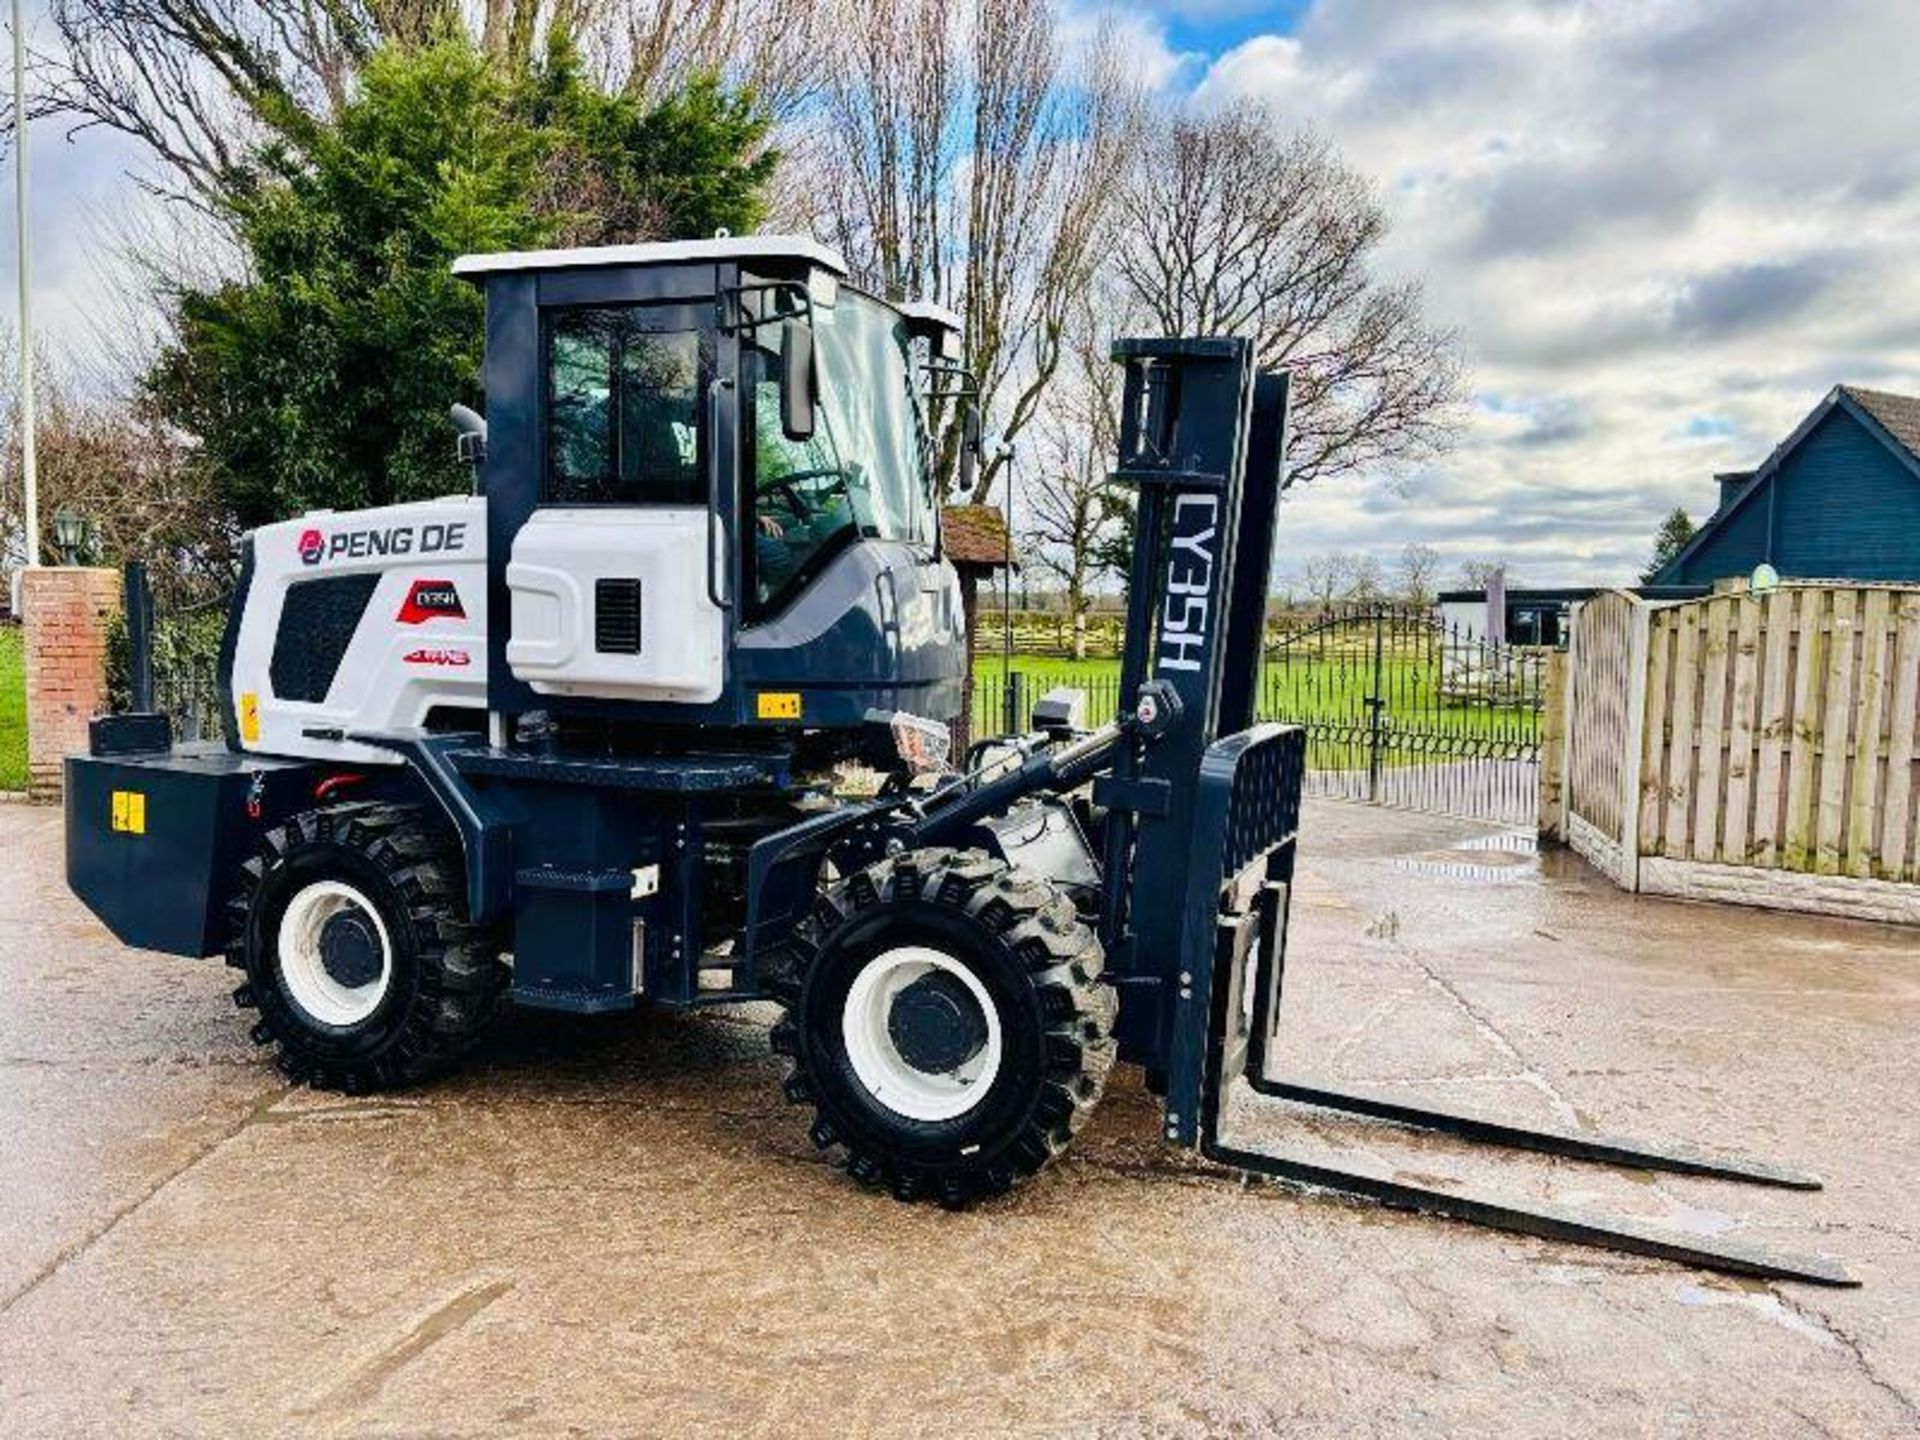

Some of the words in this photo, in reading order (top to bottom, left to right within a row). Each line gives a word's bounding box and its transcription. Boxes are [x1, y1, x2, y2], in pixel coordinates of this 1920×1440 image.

[329, 528, 413, 560] PENG
[419, 522, 466, 552] DE
[1159, 493, 1218, 671] CY35H
